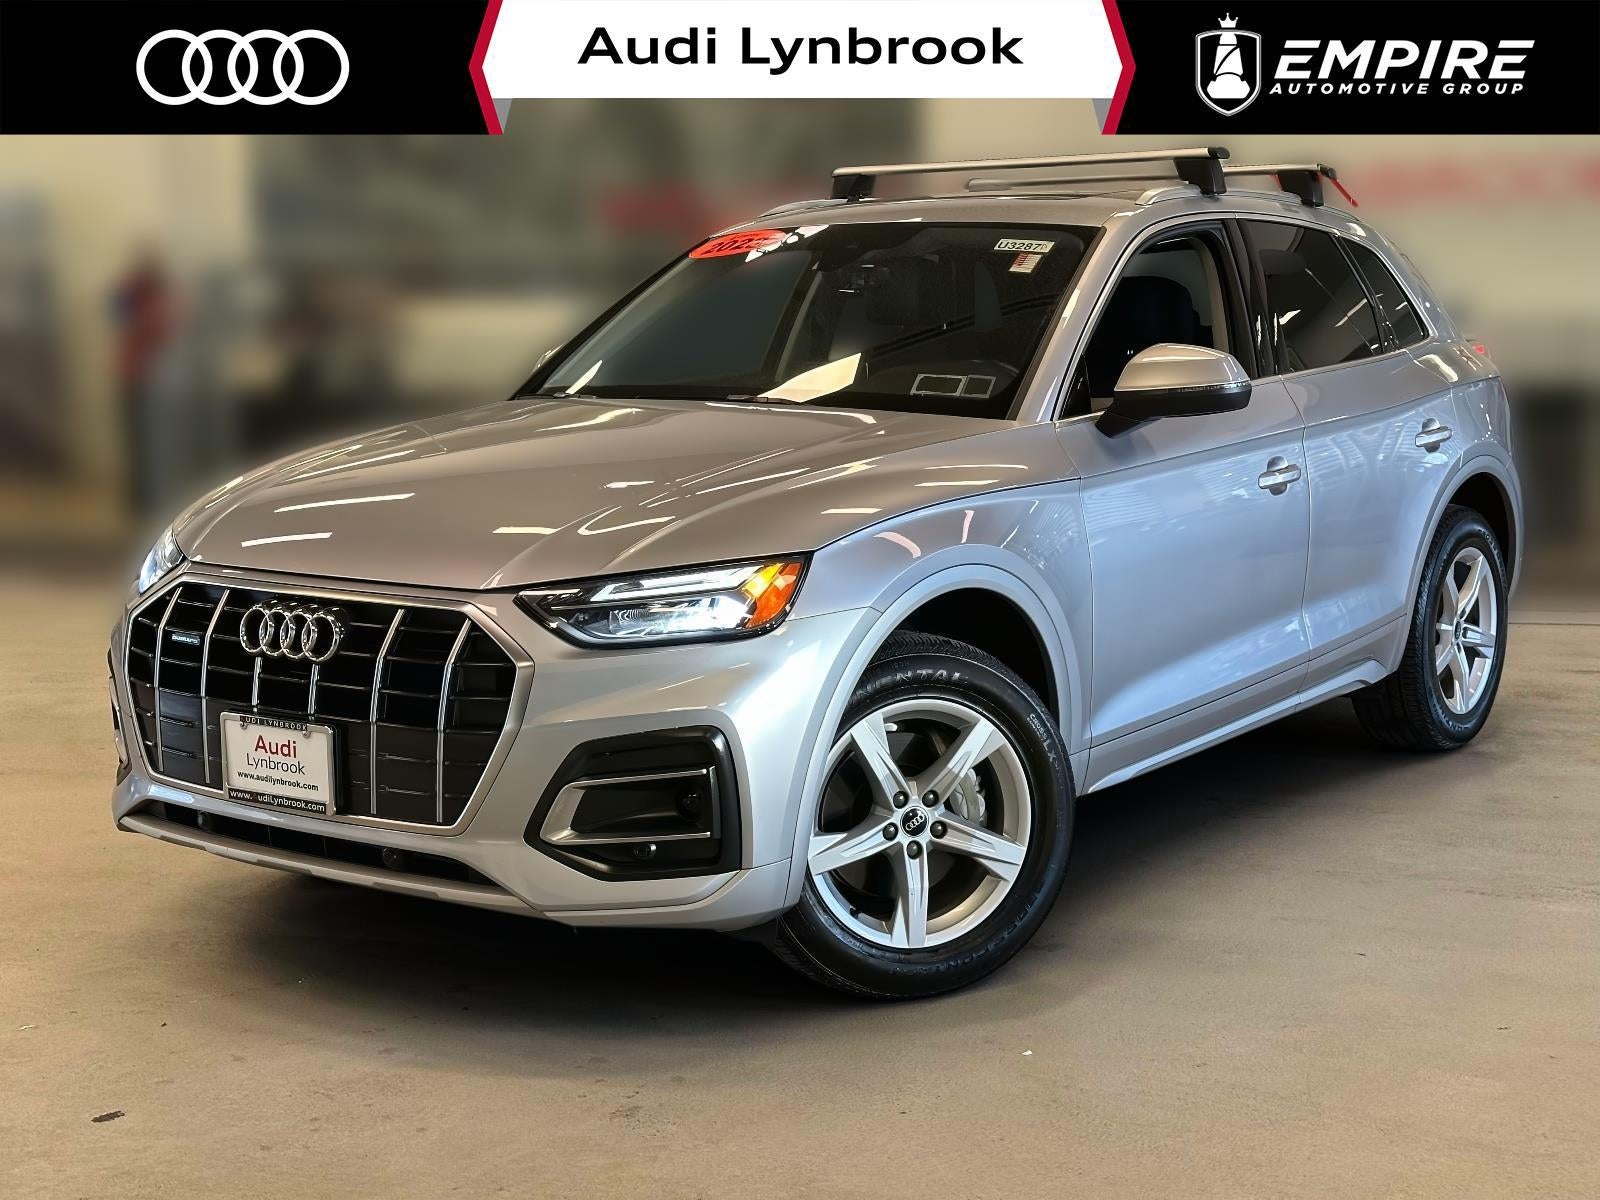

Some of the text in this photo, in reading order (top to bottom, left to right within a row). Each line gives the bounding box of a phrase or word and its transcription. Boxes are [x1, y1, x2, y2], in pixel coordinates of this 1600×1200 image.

[264, 720, 307, 731] LYNBROOK
[254, 735, 297, 758] Audi
[246, 753, 306, 775] Lynbrook
[237, 771, 319, 791] www.audilynbrook.com
